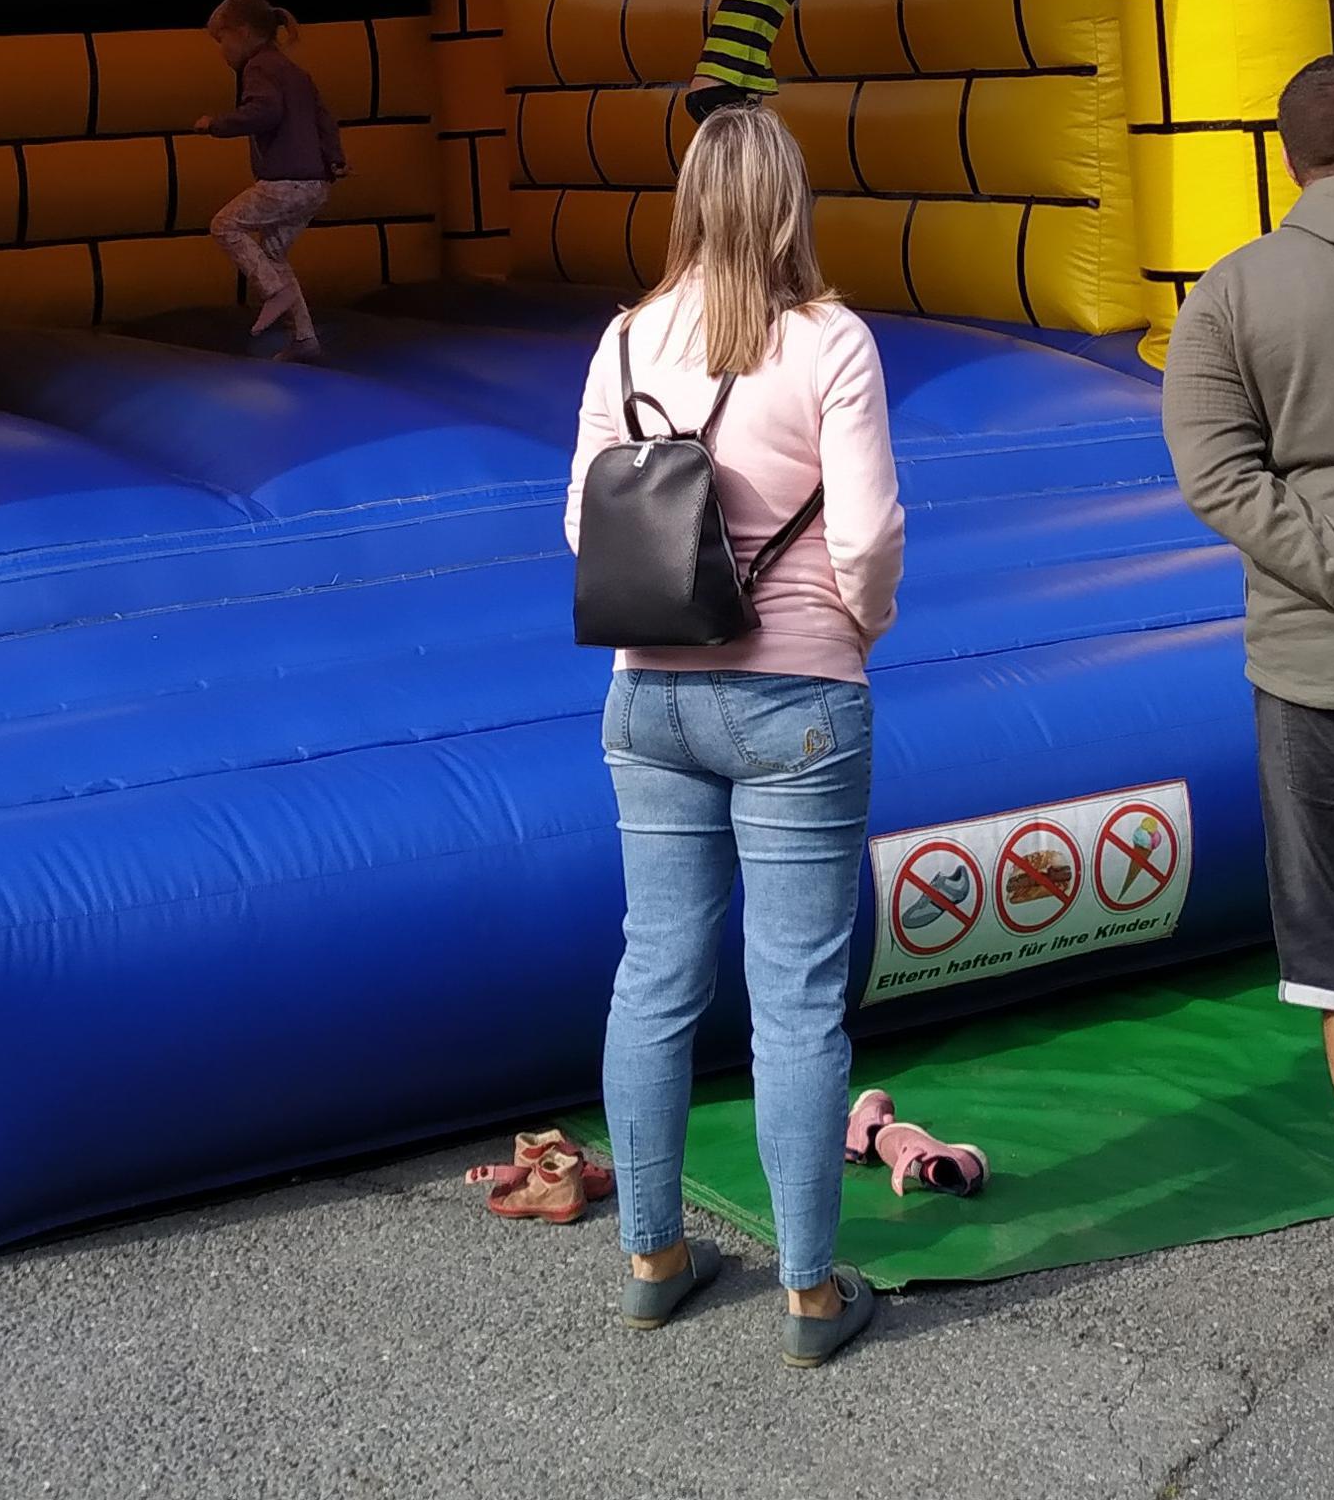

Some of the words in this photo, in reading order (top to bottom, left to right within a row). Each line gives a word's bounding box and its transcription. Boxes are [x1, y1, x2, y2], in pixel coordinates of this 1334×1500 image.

[876, 965, 941, 991] Eltern
[946, 950, 1013, 975] haften
[1017, 940, 1047, 960] für
[1050, 930, 1089, 952] ihre
[1093, 915, 1160, 941] Kinder
